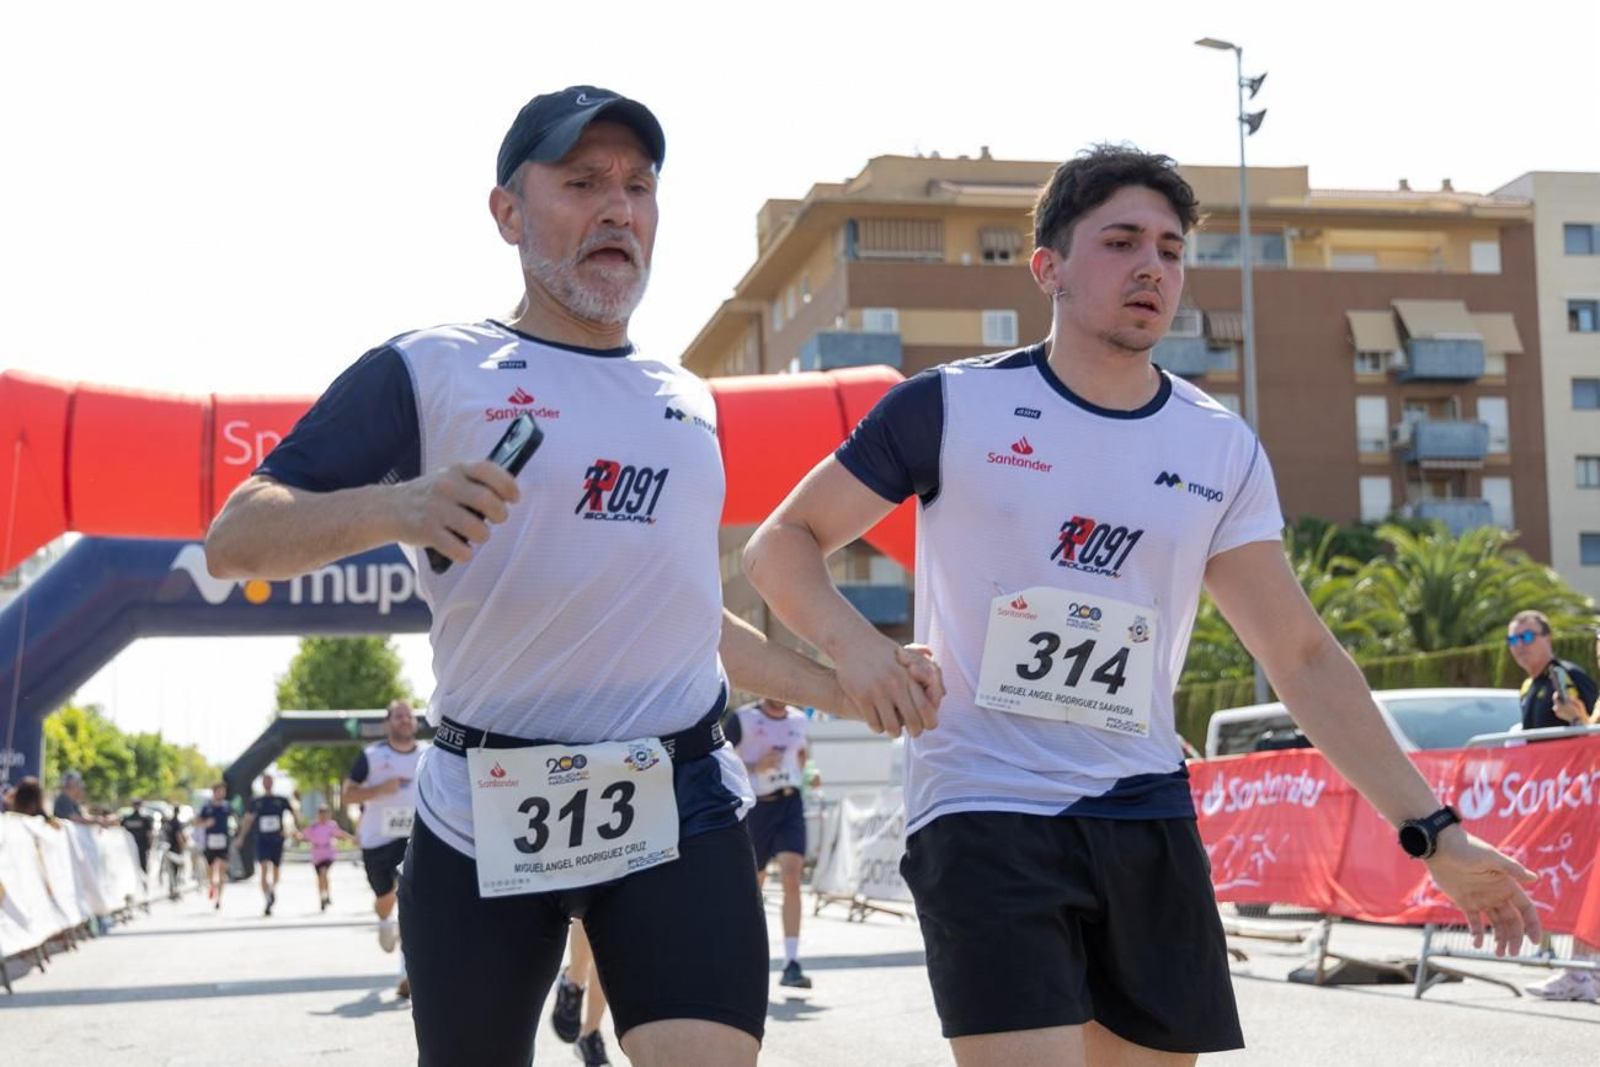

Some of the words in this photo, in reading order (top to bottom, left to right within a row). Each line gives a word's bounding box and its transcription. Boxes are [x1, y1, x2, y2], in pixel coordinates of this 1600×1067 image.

[986, 452, 1053, 473] Santander
[1188, 482, 1224, 503] mupo
[582, 512, 653, 524] SOLIDARIA
[1057, 560, 1119, 577] SOLIDARIA
[290, 564, 424, 615] mup
[997, 607, 1038, 621] Santander
[1016, 631, 1131, 695] 314
[999, 683, 1027, 698] MIGUEL
[1028, 689, 1053, 702] ANGEL
[1055, 693, 1099, 710] RODRIGUEZ
[1099, 701, 1134, 716] SAAVEDRA
[478, 779, 519, 789] Santander
[1225, 768, 1326, 813] Santander
[513, 780, 636, 854] 313
[514, 859, 573, 873] MIGUELANGEL
[575, 846, 623, 866] RODRIGUEZ
[625, 841, 648, 855] CRUZ
